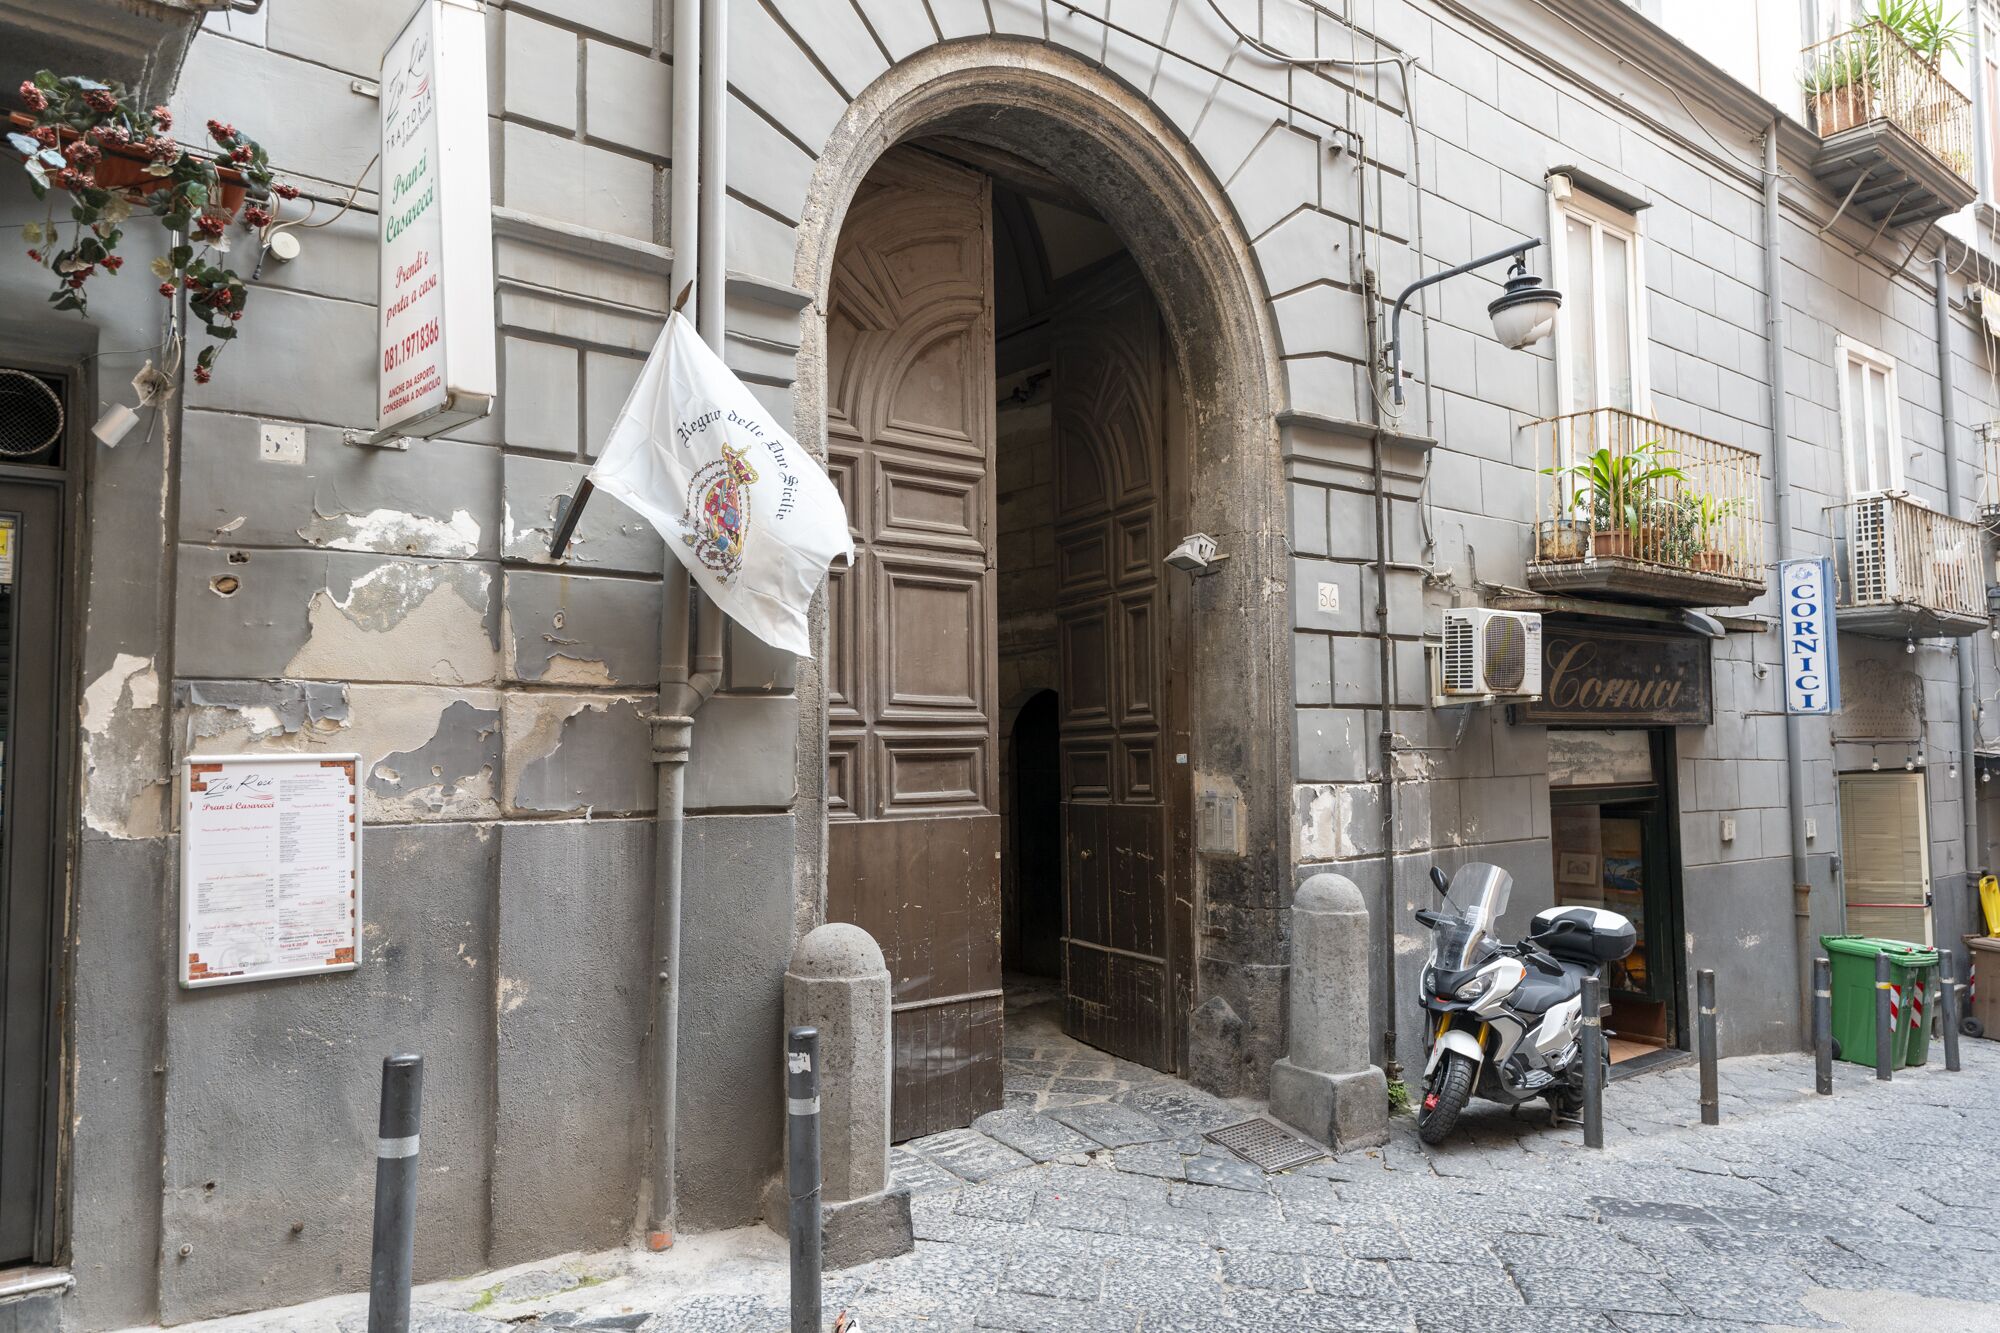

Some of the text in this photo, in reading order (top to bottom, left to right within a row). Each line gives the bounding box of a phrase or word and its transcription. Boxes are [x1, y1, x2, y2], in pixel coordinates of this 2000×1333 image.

[386, 88, 431, 153] TRATTORIA
[392, 147, 427, 205] Pranzi
[386, 177, 433, 243] Casarecci
[396, 250, 429, 288] Prendi e
[386, 273, 437, 327] porta a casa
[384, 316, 439, 373] 081.19718366
[383, 376, 441, 415] CONSEGNA A DOMICILIO
[388, 364, 436, 398] ANCHE DA ASPORTO
[676, 410, 799, 521] Regno delle Due Sicilie
[1319, 586, 1337, 608] 56
[1546, 639, 1682, 708] Cornici
[1791, 584, 1820, 709] CORNICI
[202, 801, 276, 811] Pranzi Casarecci
[204, 777, 234, 796] Zia
